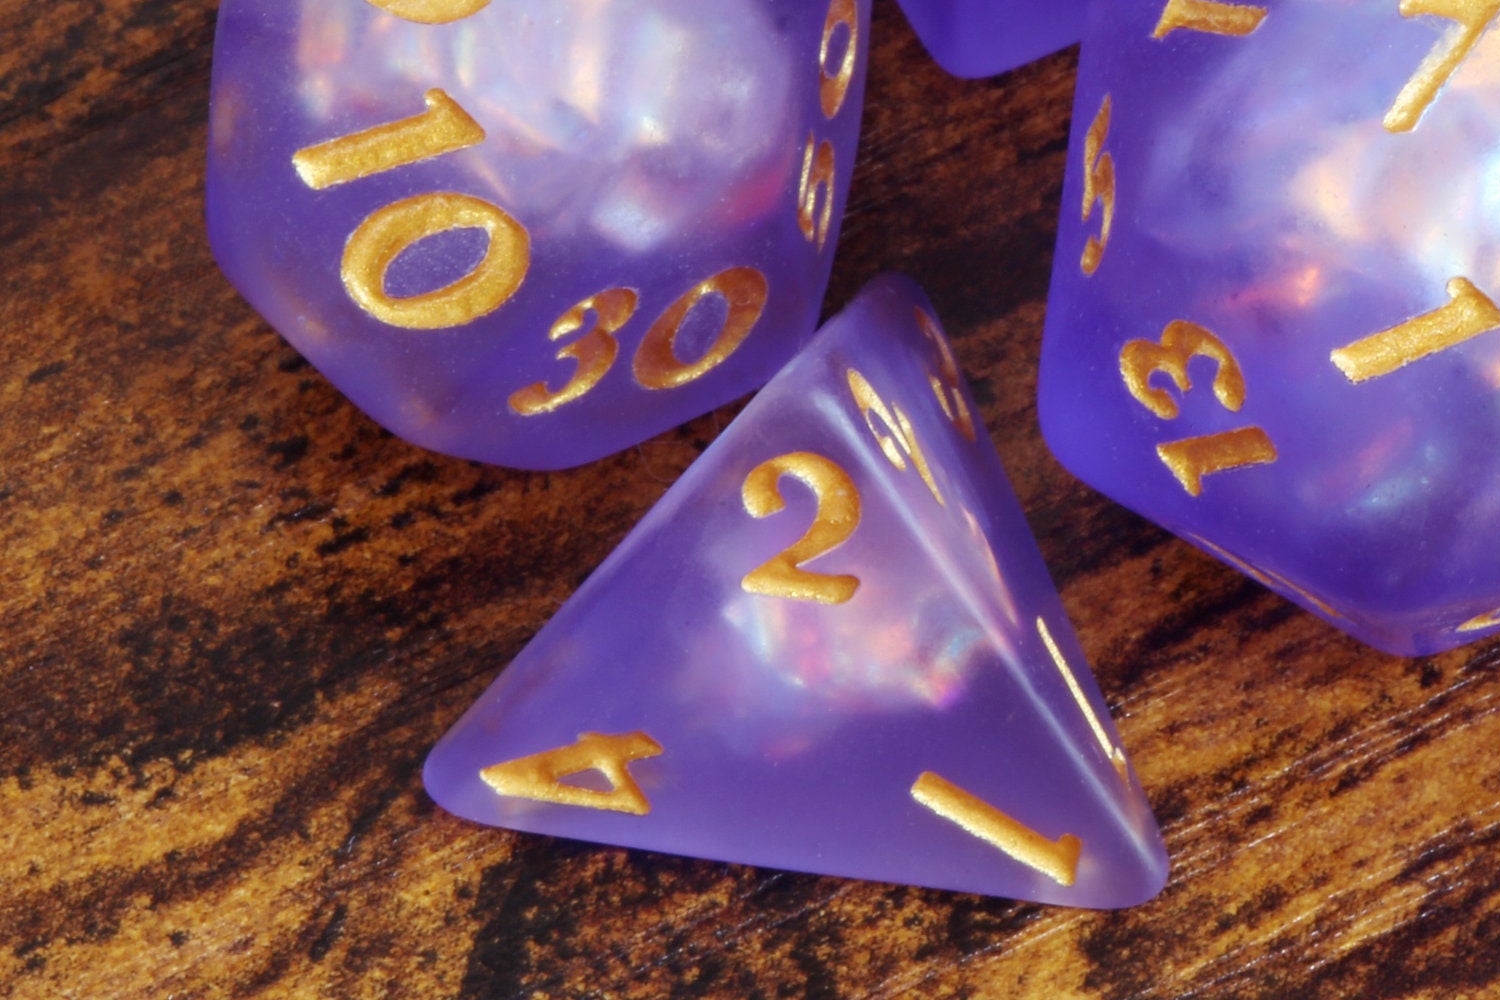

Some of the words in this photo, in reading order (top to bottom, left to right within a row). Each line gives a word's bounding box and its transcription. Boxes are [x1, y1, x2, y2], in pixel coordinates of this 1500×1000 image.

[291, 88, 531, 330] 10
[508, 266, 768, 416] 30
[1119, 319, 1278, 498] 13
[741, 451, 861, 604] 2
[479, 730, 664, 816] 4
[910, 770, 1081, 886] 1
